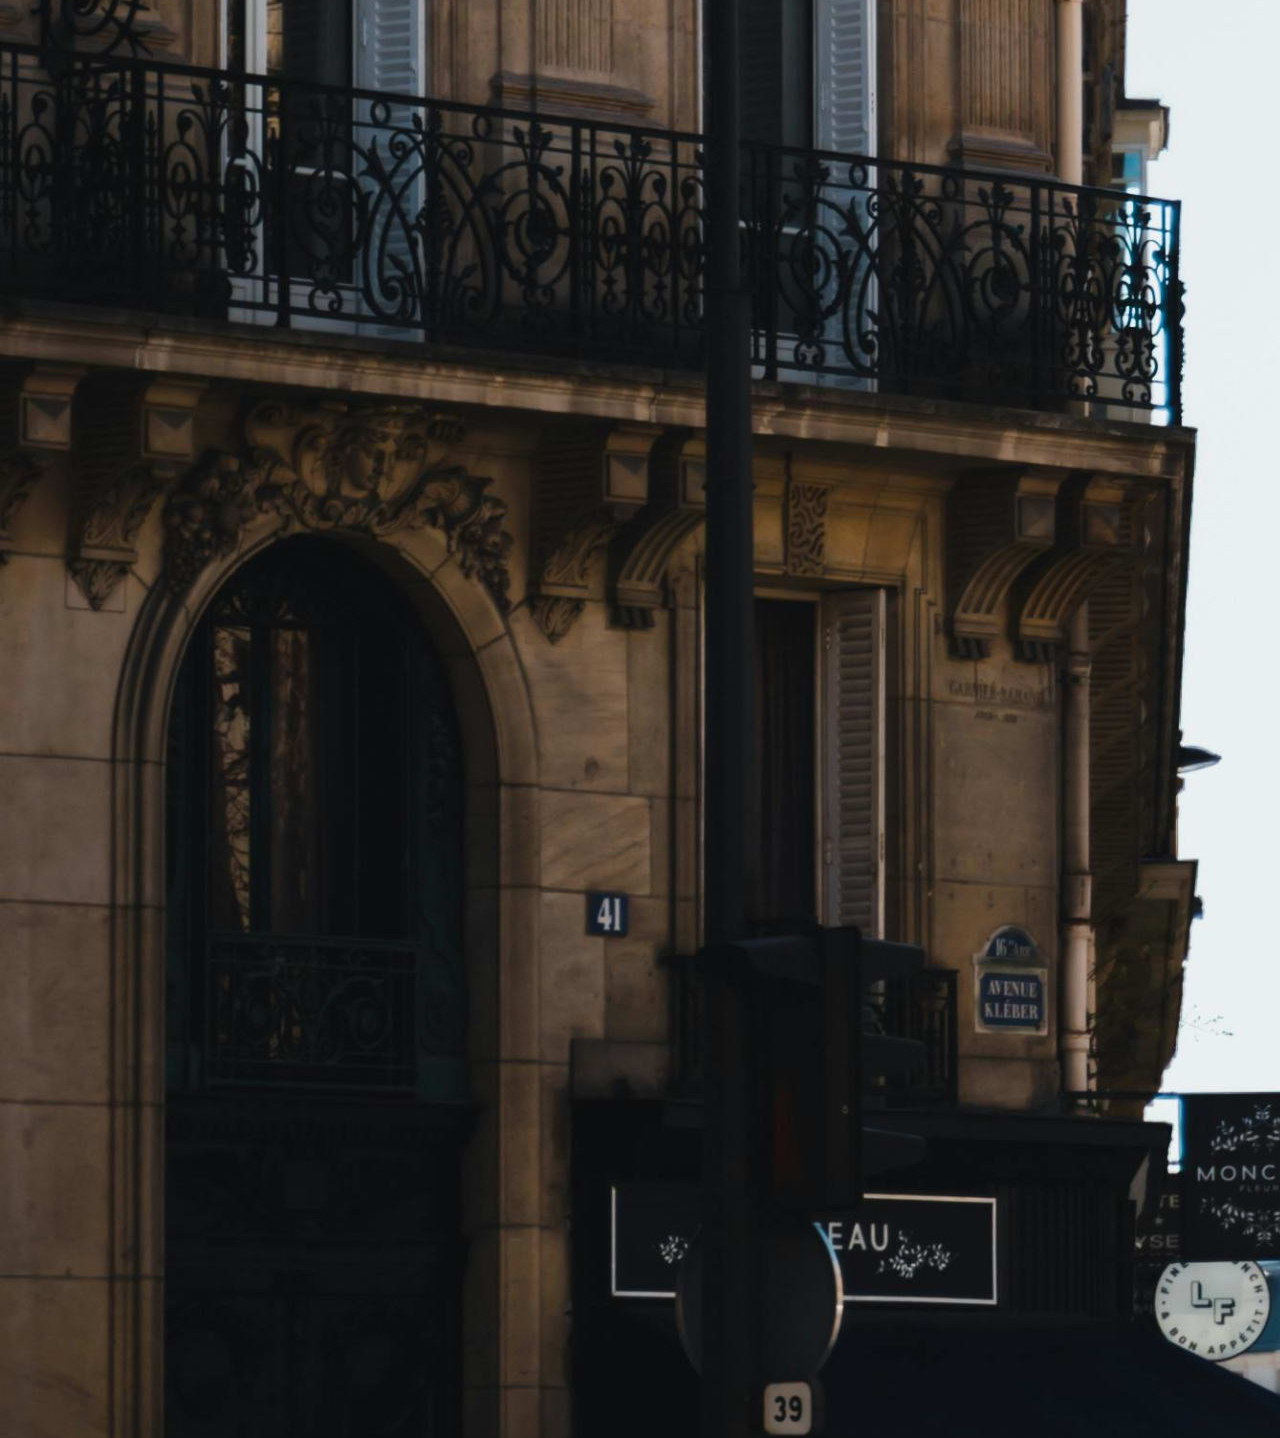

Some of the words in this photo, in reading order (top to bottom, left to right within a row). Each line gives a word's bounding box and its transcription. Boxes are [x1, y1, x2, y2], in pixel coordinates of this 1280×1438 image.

[597, 897, 621, 931] 41
[987, 980, 1038, 999] AVENUE
[984, 998, 1038, 1020] KLÉBER
[1169, 1327, 1198, 1351] BON
[774, 1395, 803, 1422] 39
